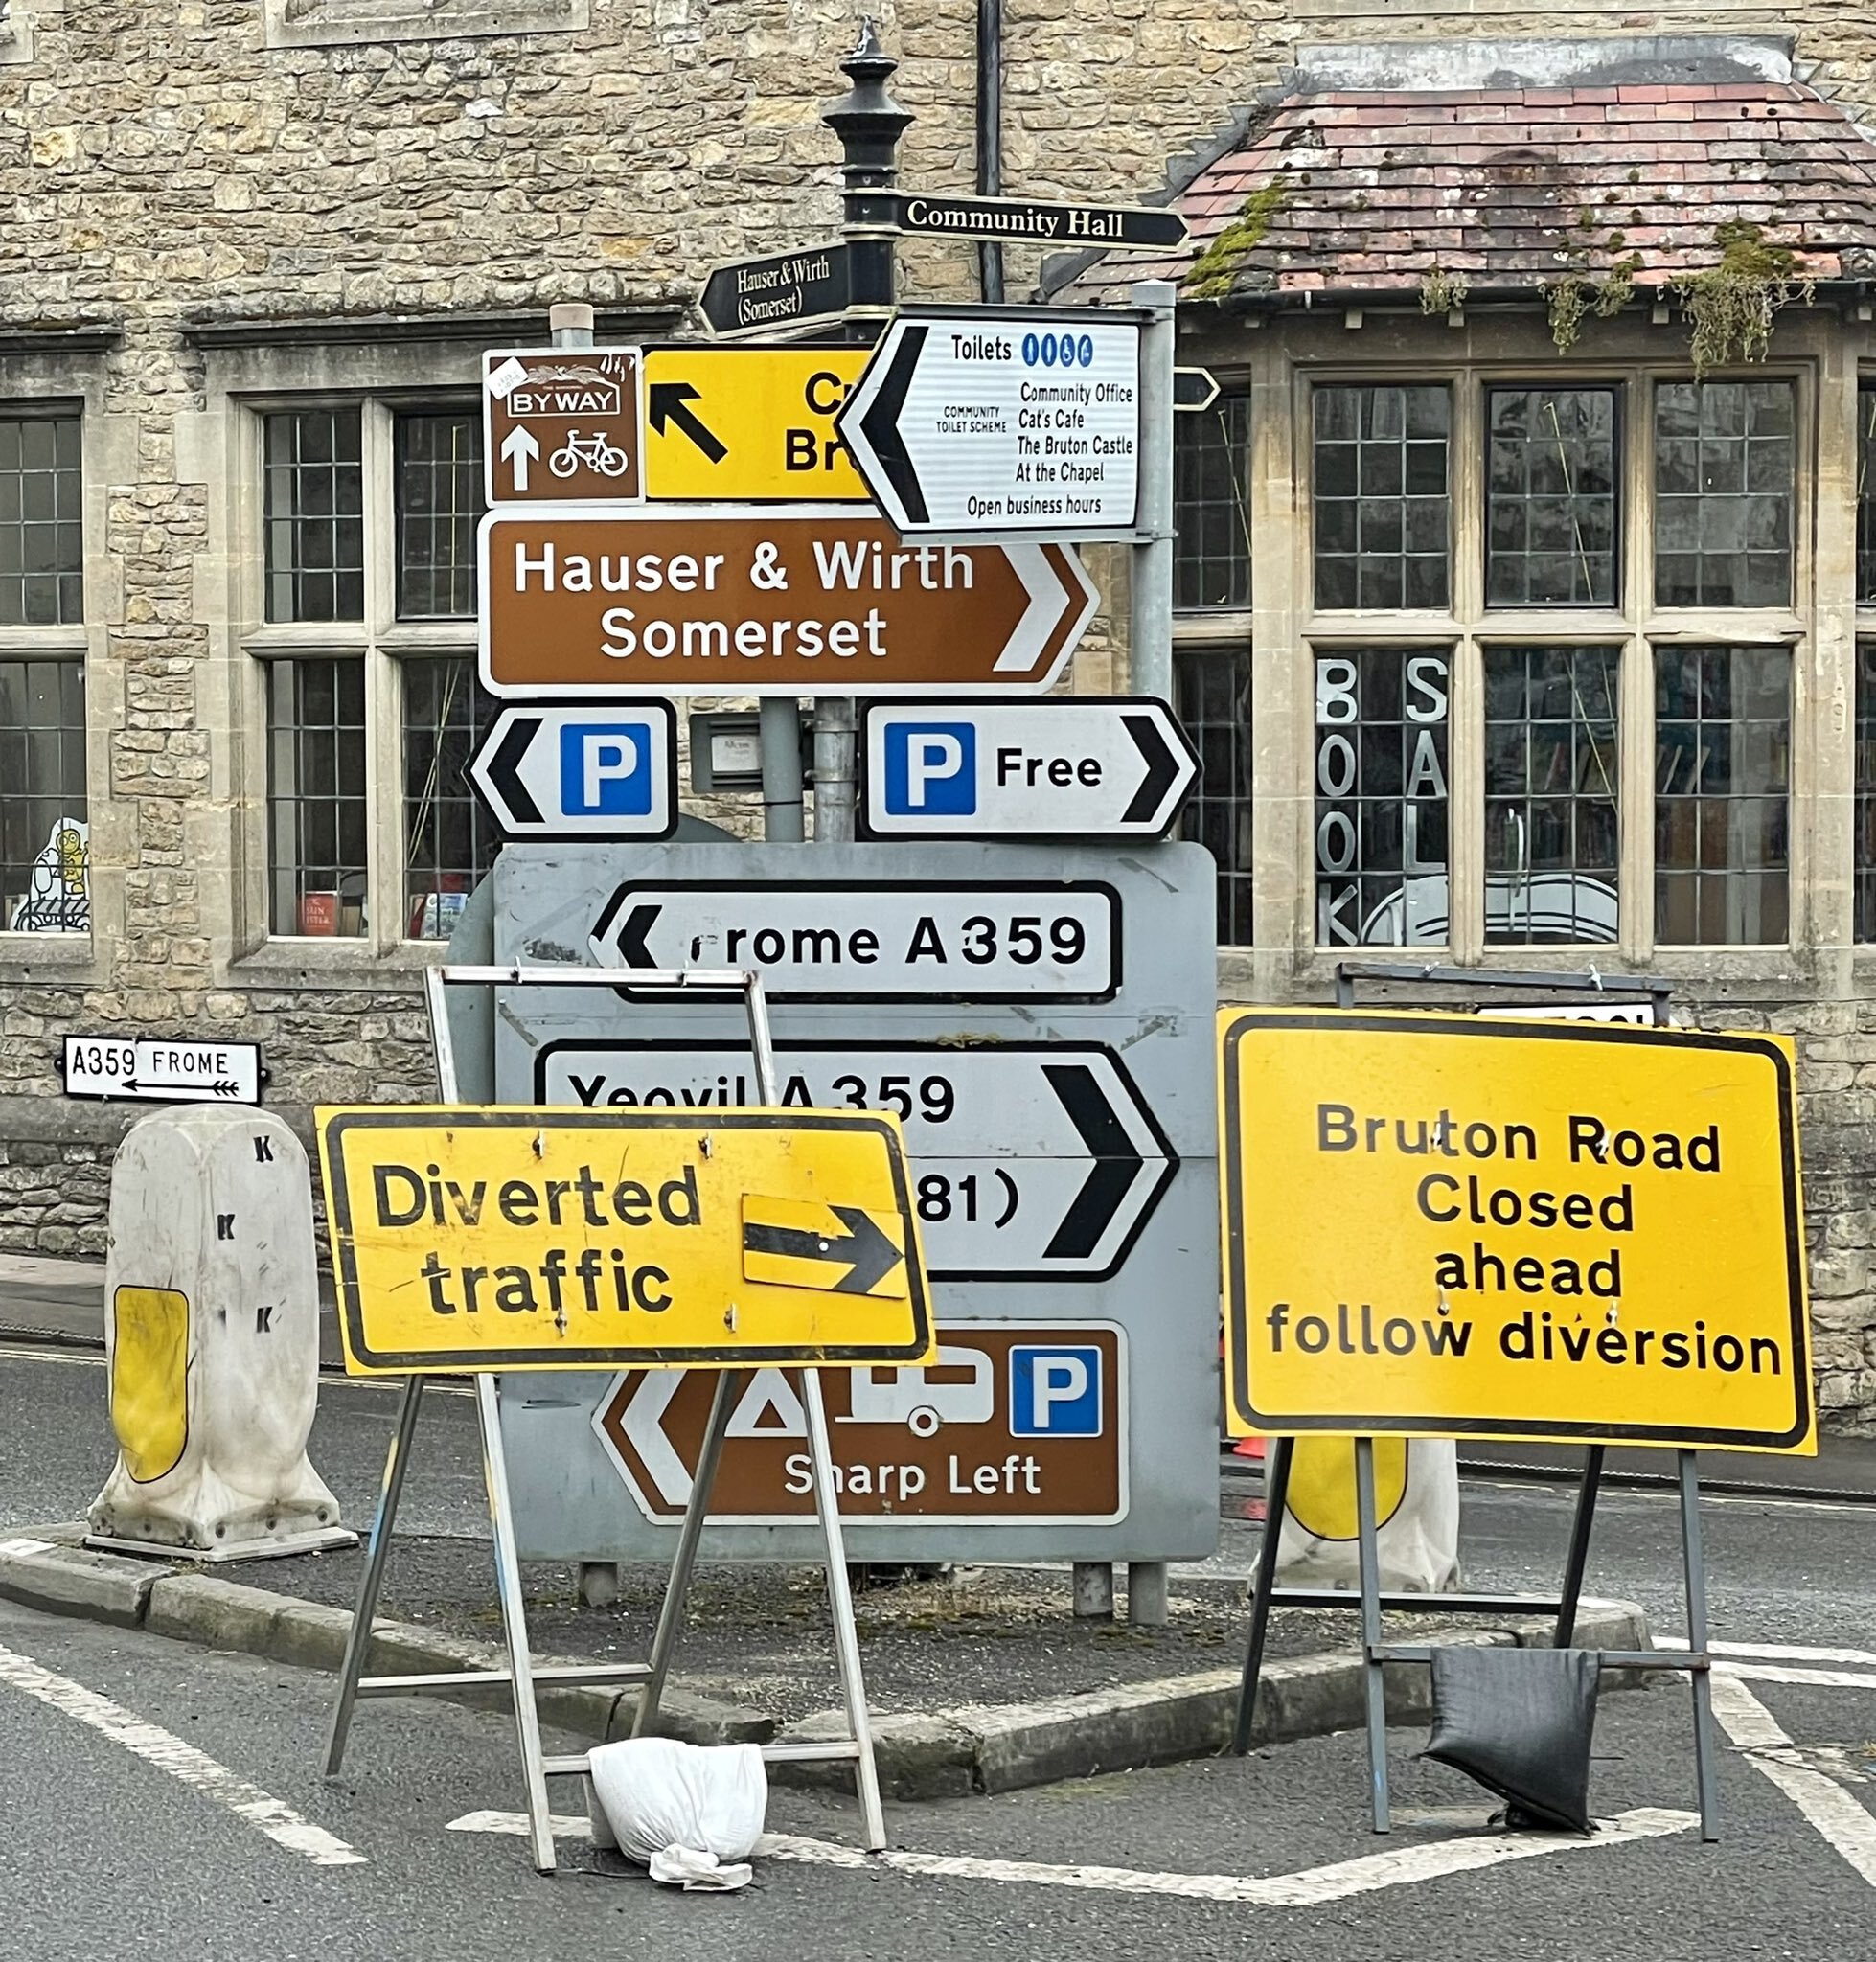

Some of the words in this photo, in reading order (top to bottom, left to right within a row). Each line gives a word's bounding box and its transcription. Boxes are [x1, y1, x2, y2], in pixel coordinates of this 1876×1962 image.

[907, 201, 1059, 237] Community
[1068, 210, 1123, 237] Hall
[737, 268, 779, 293] Hauser
[780, 262, 792, 285] &
[792, 255, 830, 283] Wirth
[738, 286, 802, 325] (Somerset)
[951, 335, 1012, 360] Toilets
[513, 392, 613, 412] BYWAY
[944, 406, 999, 418] COMMUNITY
[1020, 382, 1091, 405] Community
[1096, 383, 1132, 402] Office
[936, 422, 967, 433] TOILET
[970, 422, 1006, 433] SCHEME
[1019, 408, 1050, 428] Cat's
[1055, 409, 1084, 428] Cafe
[787, 429, 858, 471] Br
[1018, 436, 1040, 454] The
[1045, 436, 1087, 454] Bruton
[1092, 435, 1132, 454] Castle
[1016, 462, 1030, 482] At
[1036, 463, 1055, 481] the
[1061, 462, 1104, 484] Chapel
[968, 496, 1001, 518] Open
[1007, 495, 1062, 515] business
[1066, 494, 1102, 514] hours
[515, 543, 723, 592] Hauser
[749, 541, 789, 590] &
[812, 540, 972, 590] Wirth
[601, 607, 887, 658] Somerset
[583, 734, 637, 806] P
[907, 734, 962, 806] P
[996, 747, 1103, 787] Free
[904, 916, 1086, 965] A359
[72, 1046, 135, 1076] A359
[153, 1051, 229, 1074] FROME
[781, 1075, 955, 1123] A359
[1317, 1104, 1537, 1160] Bruton
[1568, 1116, 1721, 1173] Road
[372, 1165, 701, 1227] Diverted
[916, 1168, 1018, 1229] 81)
[1417, 1173, 1634, 1232] Closed
[421, 1248, 673, 1315] traffic
[1436, 1242, 1622, 1297] ahead
[1267, 1304, 1472, 1357] follow
[1499, 1312, 1781, 1375] diversion
[1032, 1357, 1087, 1428] P
[949, 1455, 1041, 1494] Left
